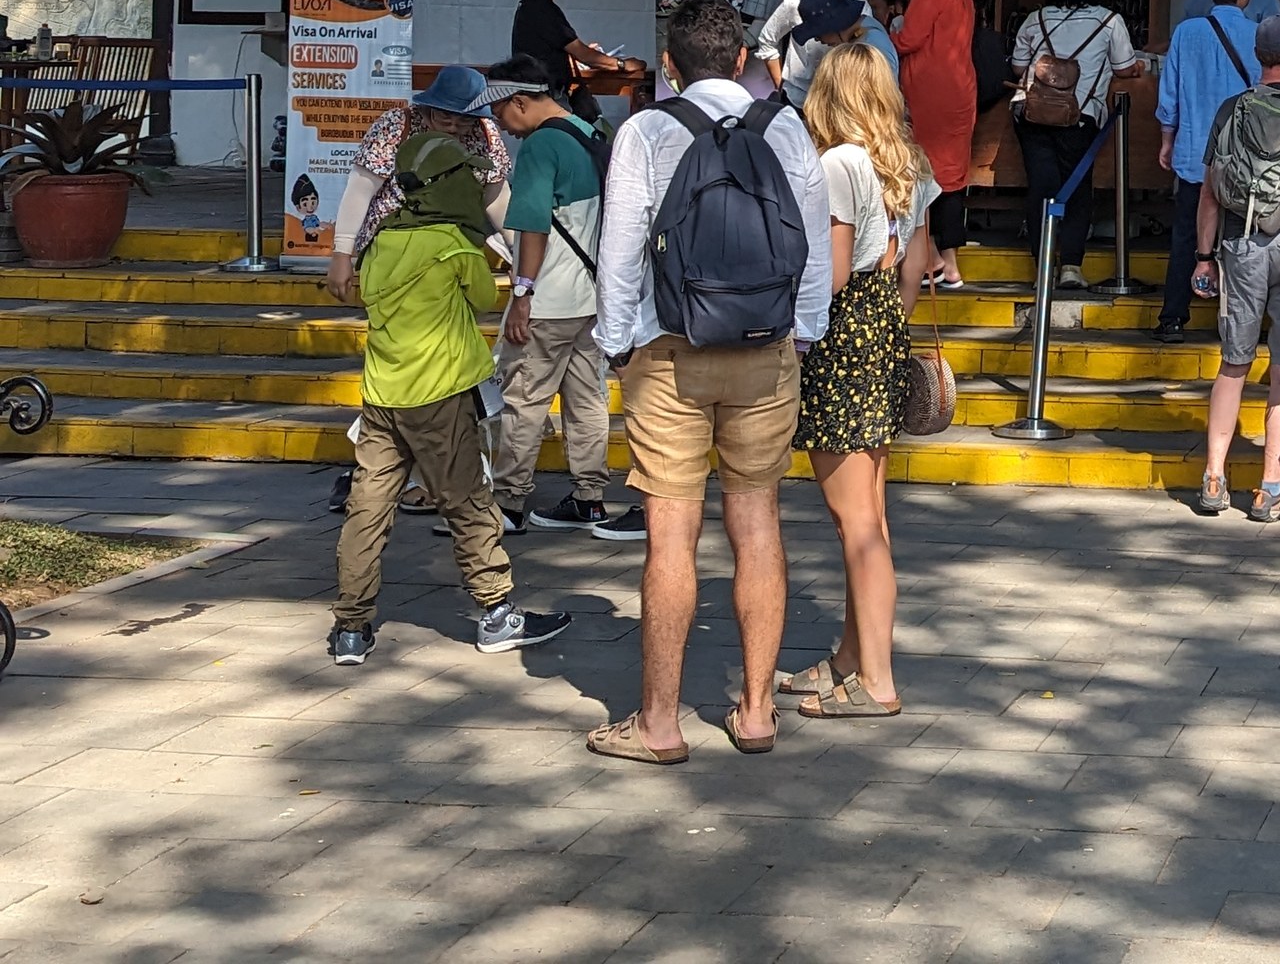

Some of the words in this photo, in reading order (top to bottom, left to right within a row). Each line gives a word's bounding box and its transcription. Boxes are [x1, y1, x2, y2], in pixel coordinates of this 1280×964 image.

[292, 25, 317, 37] Visa
[319, 26, 336, 38] On
[337, 26, 377, 39] Arrival
[293, 45, 356, 64] EXTENSION
[389, 47, 407, 55] VISA
[292, 72, 347, 90] SERVICES
[296, 99, 308, 107] YOU
[308, 99, 320, 107] CAN
[321, 99, 342, 108] EXTEND
[343, 100, 358, 108] YOUR
[359, 100, 372, 109] VISA
[305, 114, 323, 123] WHILE
[324, 114, 350, 124] ENJOYING
[351, 115, 361, 124] THE
[321, 129, 354, 139] BOROBUDUR
[329, 159, 348, 167] GATE
[308, 167, 352, 175] INTERNATIO
